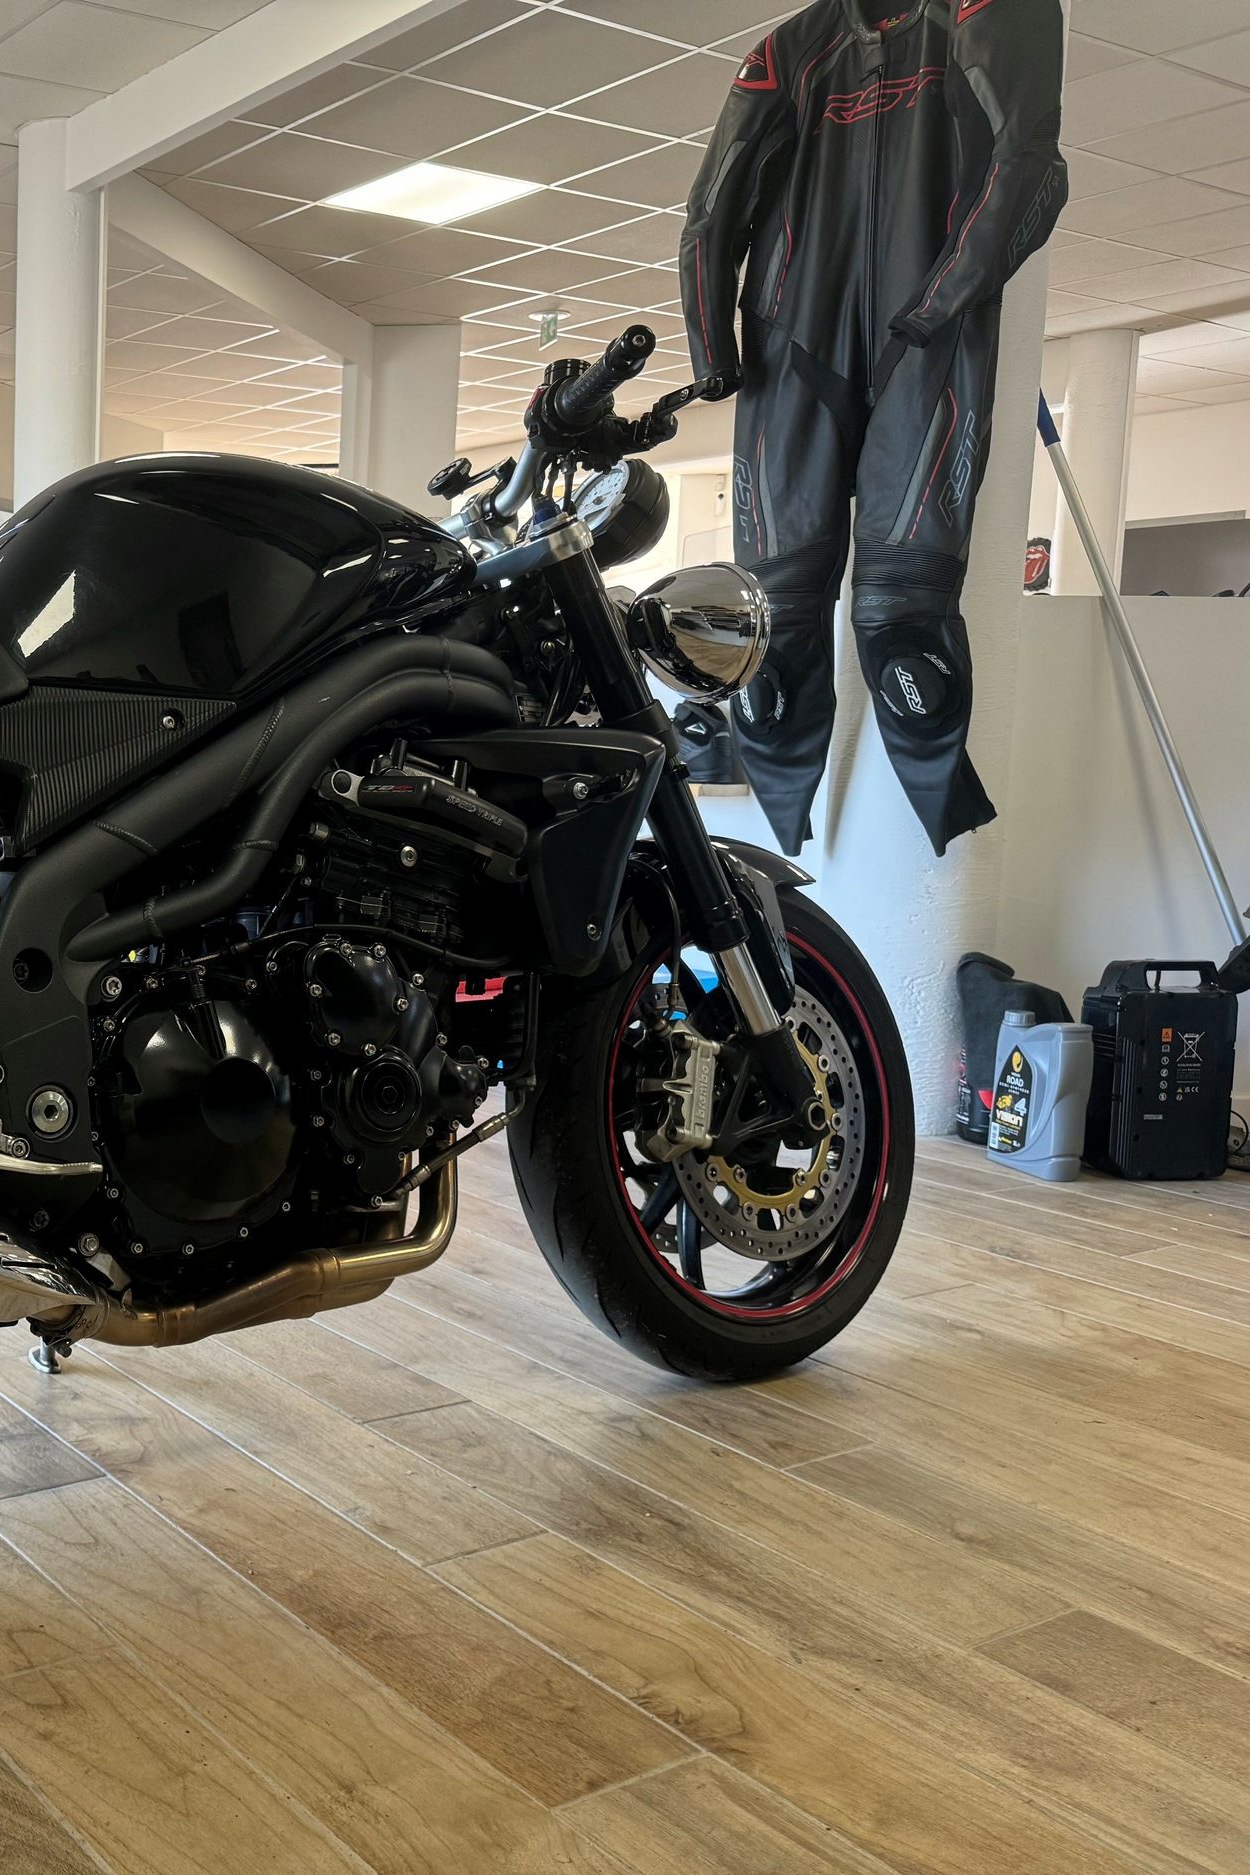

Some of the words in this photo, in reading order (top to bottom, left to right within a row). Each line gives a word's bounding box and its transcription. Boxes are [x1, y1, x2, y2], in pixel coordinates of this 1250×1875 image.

[812, 67, 945, 135] RST
[1007, 165, 1053, 270] RST
[937, 409, 980, 528] RST
[854, 595, 907, 608] RST
[922, 652, 951, 675] RST
[894, 666, 926, 714] RST
[774, 691, 785, 721] RST
[446, 794, 476, 813] SPEED
[476, 808, 504, 827] TRIPLE
[1006, 1075, 1024, 1087] ROAD
[1014, 1098, 1027, 1116] 4
